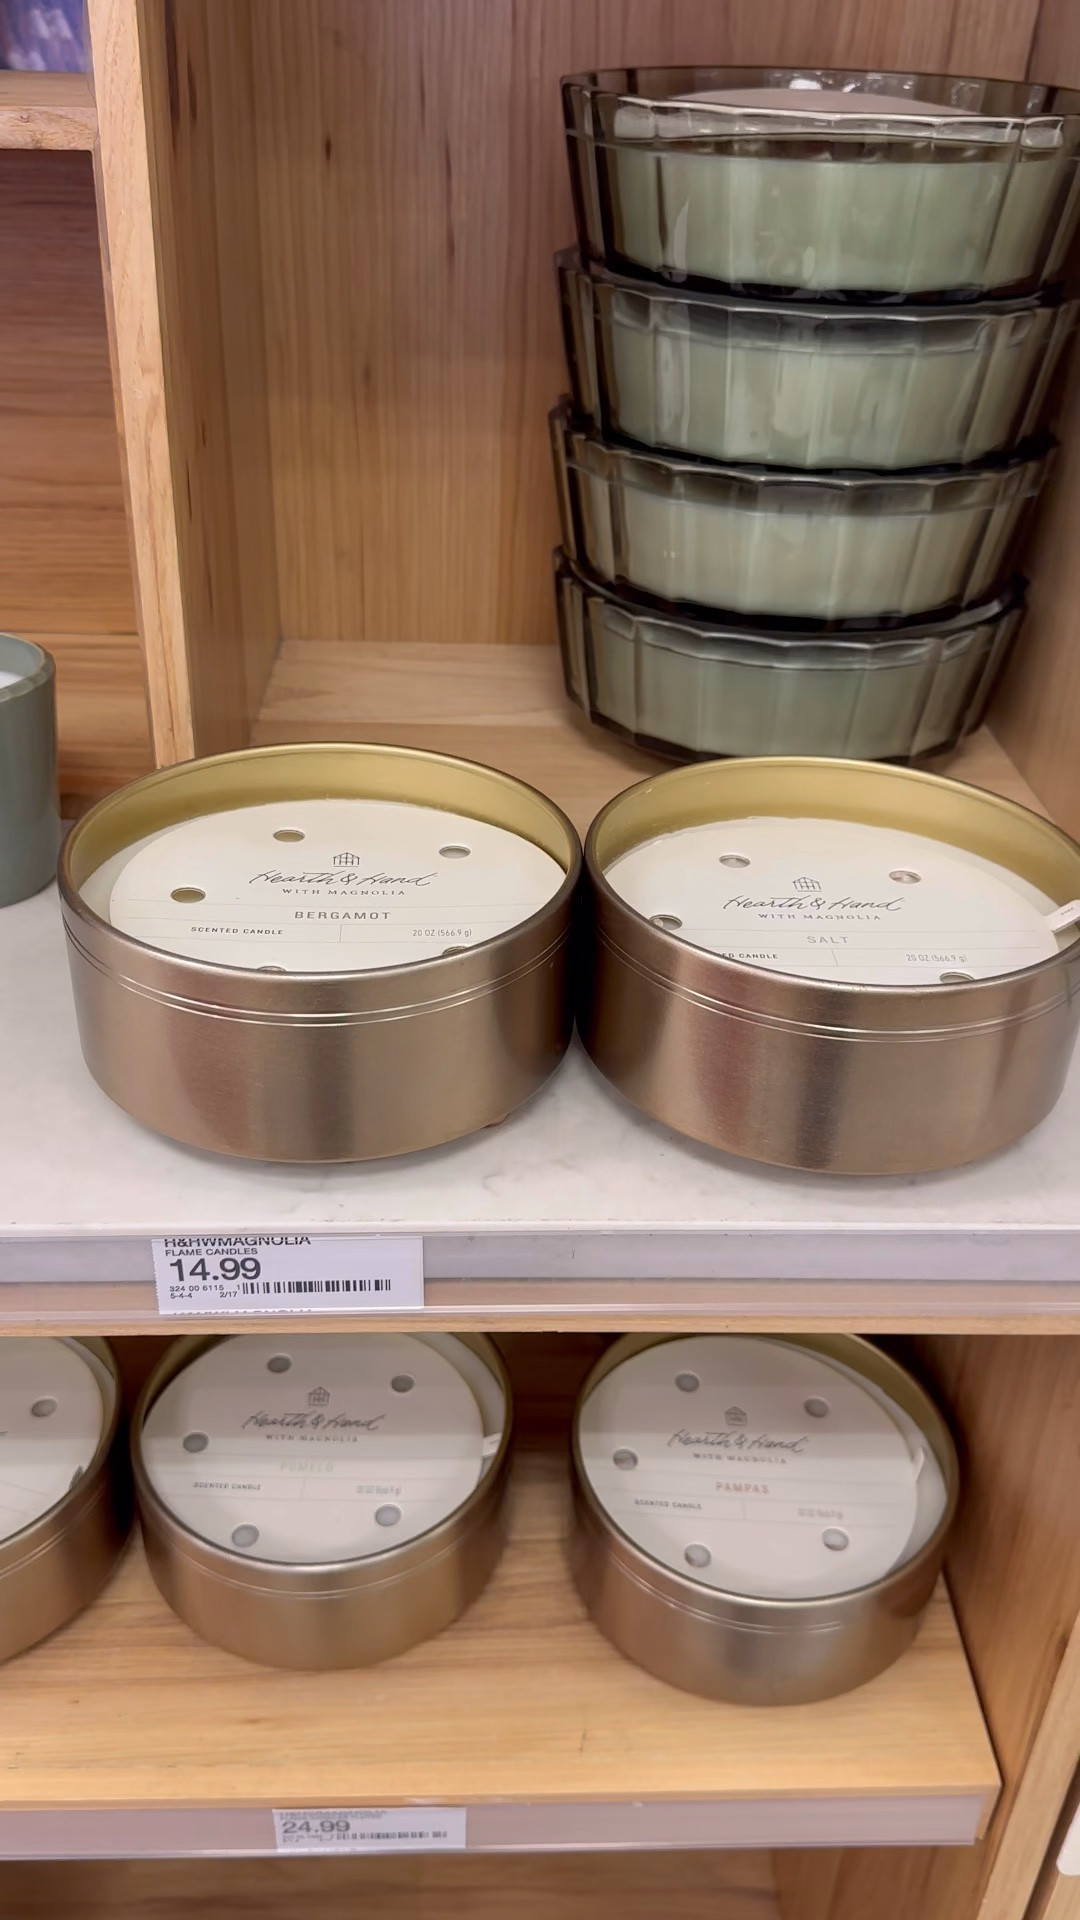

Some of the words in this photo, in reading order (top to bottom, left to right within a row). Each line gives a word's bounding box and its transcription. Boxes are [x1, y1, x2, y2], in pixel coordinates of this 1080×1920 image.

[249, 869, 337, 885] Hearth
[340, 870, 357, 886] &
[358, 871, 439, 887] Hand
[722, 894, 808, 910] Hearth
[810, 896, 827, 910] &
[829, 896, 906, 912] Hand
[294, 911, 391, 921] BERGAMOT
[757, 912, 796, 920] WITH
[803, 913, 882, 921] MAGNOLIA
[190, 926, 240, 935] SCENTED
[243, 927, 284, 936] CANDLE
[412, 928, 423, 937] 20
[424, 928, 436, 937] OZ
[806, 935, 850, 945] SALT
[738, 952, 779, 960] CANDLE
[906, 953, 916, 963] 20
[917, 953, 930, 963] OZ
[165, 1249, 202, 1257] FLAME
[205, 1247, 258, 1256] CANDLES
[169, 1257, 262, 1282] 14.99
[169, 1285, 186, 1293] 324
[188, 1284, 200, 1292] 00
[202, 1284, 225, 1292] 6115
[219, 1290, 238, 1299] 2/17
[715, 1481, 771, 1495] PAMPAS
[282, 1819, 351, 1834] 24.99
